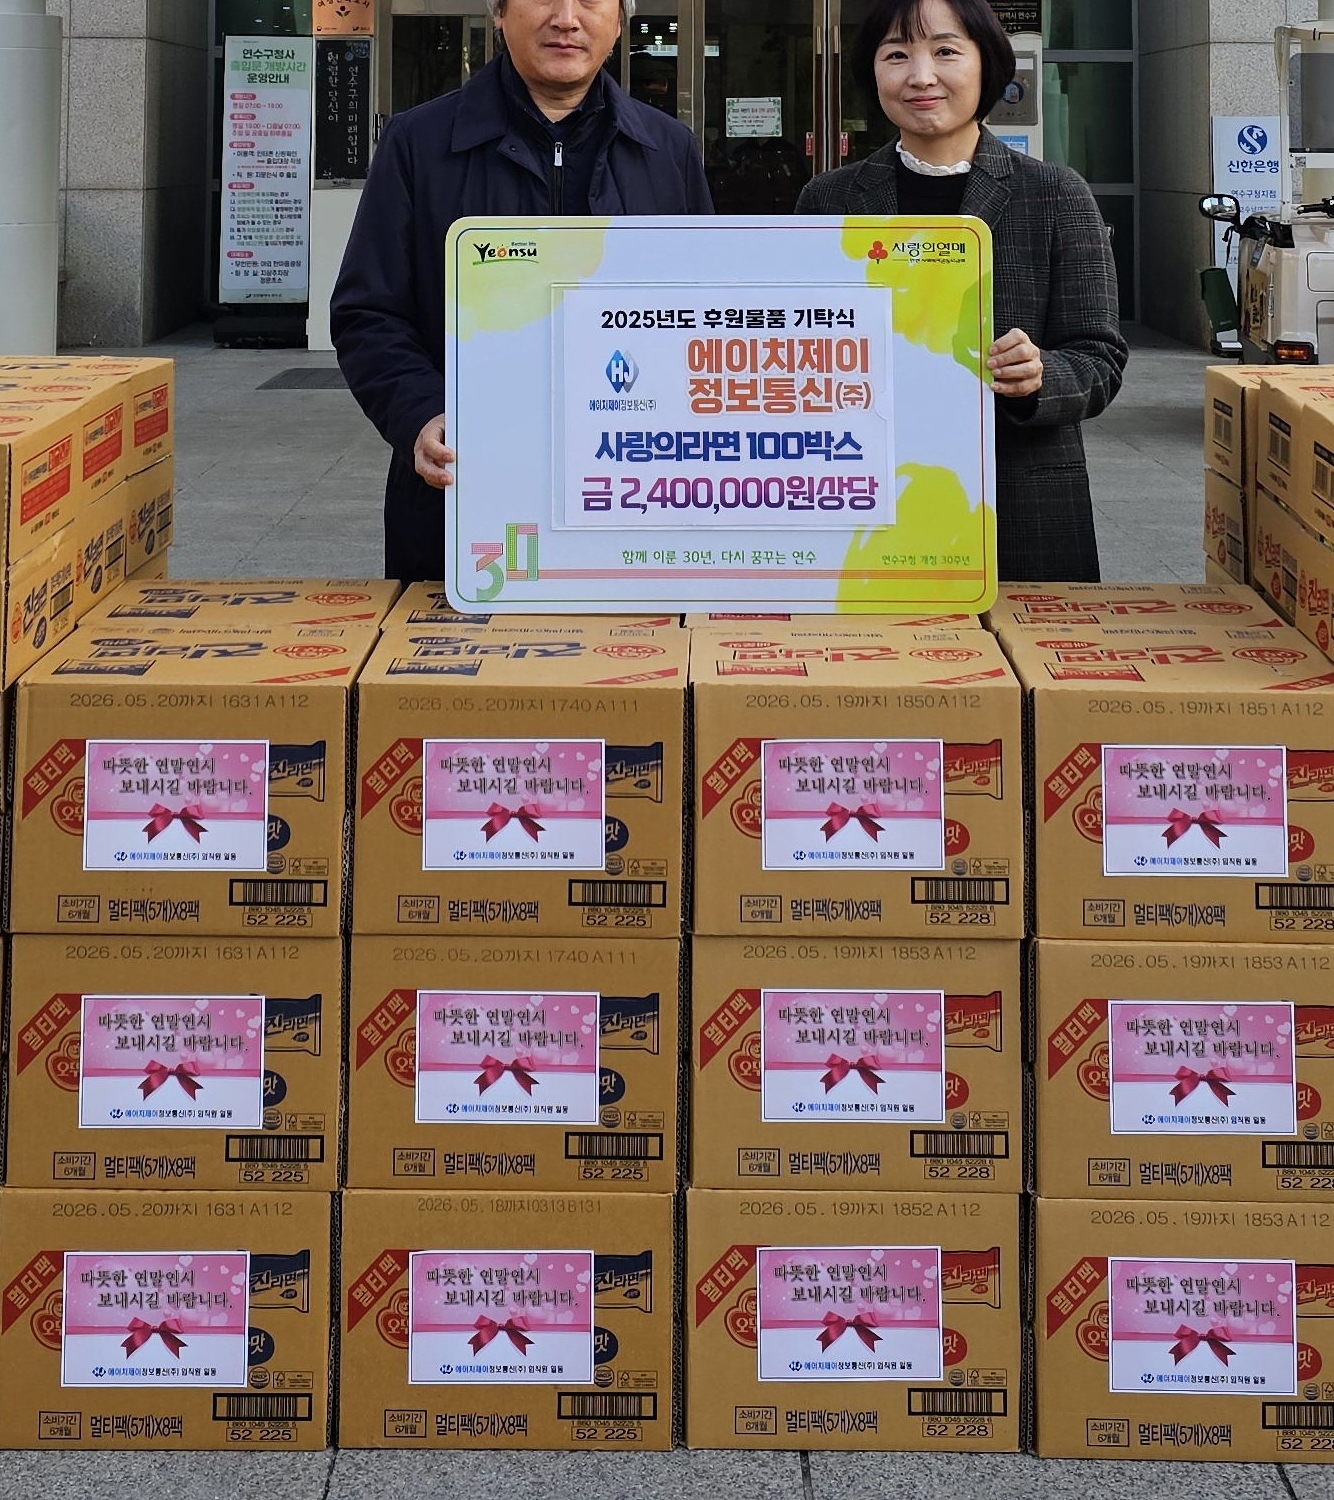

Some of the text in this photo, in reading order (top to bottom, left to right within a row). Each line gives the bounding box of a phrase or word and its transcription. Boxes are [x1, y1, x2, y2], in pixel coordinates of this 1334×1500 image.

[1227, 160, 1279, 173] 신한은행
[1231, 189, 1277, 199] 연수구청지점
[473, 242, 537, 262] Yeonsu
[892, 242, 966, 257] 사랑의열매
[601, 308, 855, 329] 2025년도 후원물품 기탁식
[687, 337, 869, 374] 에이치제이
[611, 360, 634, 383] HJ
[687, 377, 872, 414] 정보통신(주)
[595, 431, 863, 462] 사랑의라면 100박스
[582, 476, 879, 514] 금 2,400,000원상당
[622, 550, 647, 565] 함께
[721, 550, 745, 564] 다시
[751, 550, 786, 565] 꿈꾸는
[792, 550, 817, 565] 연수
[706, 742, 754, 794] 멀티팩
[779, 756, 891, 773] 따뜻한 연말연시
[795, 777, 929, 795] 보내시길 바랍니다.
[744, 899, 777, 908] 소비기간
[750, 909, 772, 920] 6개월
[929, 913, 991, 924] 52 228
